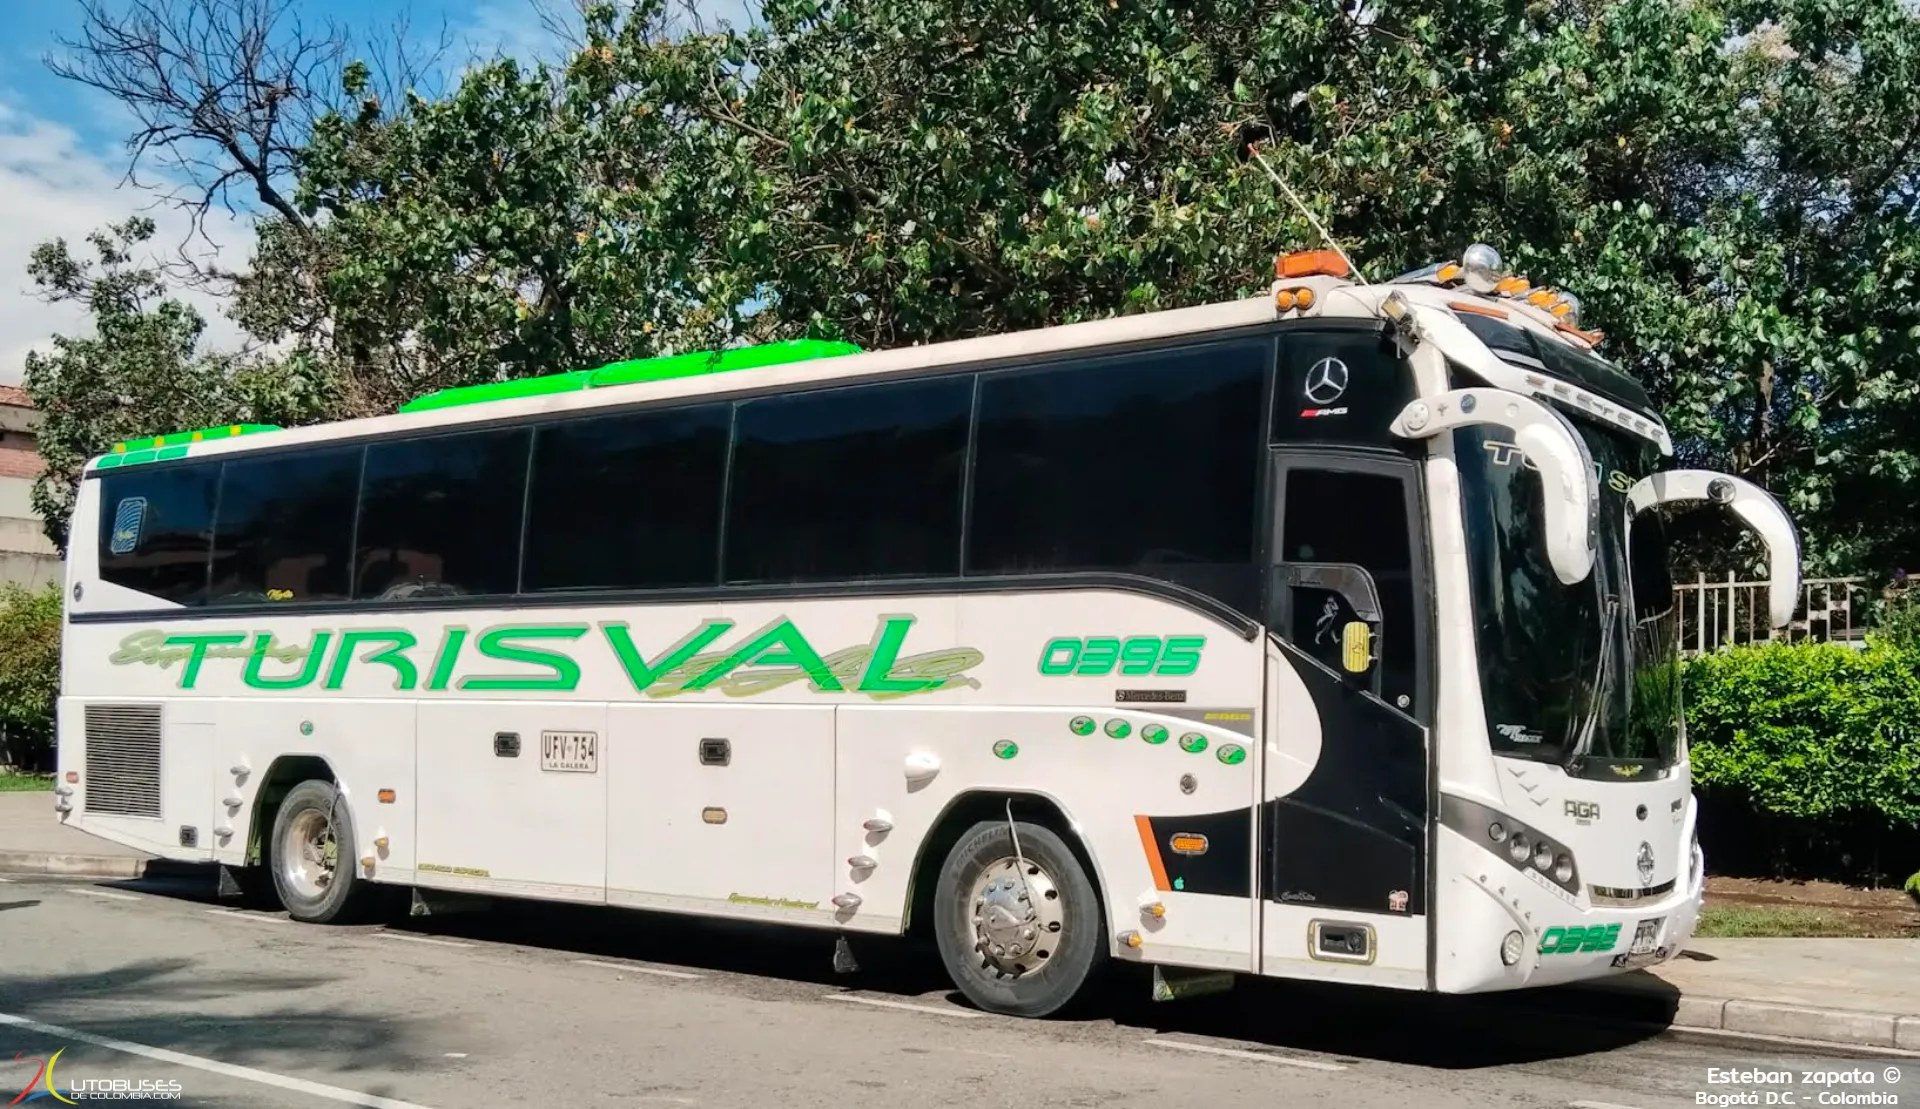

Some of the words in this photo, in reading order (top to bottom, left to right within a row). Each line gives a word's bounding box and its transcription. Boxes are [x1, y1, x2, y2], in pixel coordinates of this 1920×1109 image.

[1312, 406, 1348, 417] AMG
[162, 613, 945, 693] TURISVAL
[1038, 635, 1207, 677] 0395
[1125, 690, 1185, 701] Mercedes-Benz
[1563, 799, 1600, 820] AGA
[1539, 921, 1625, 955] 0395
